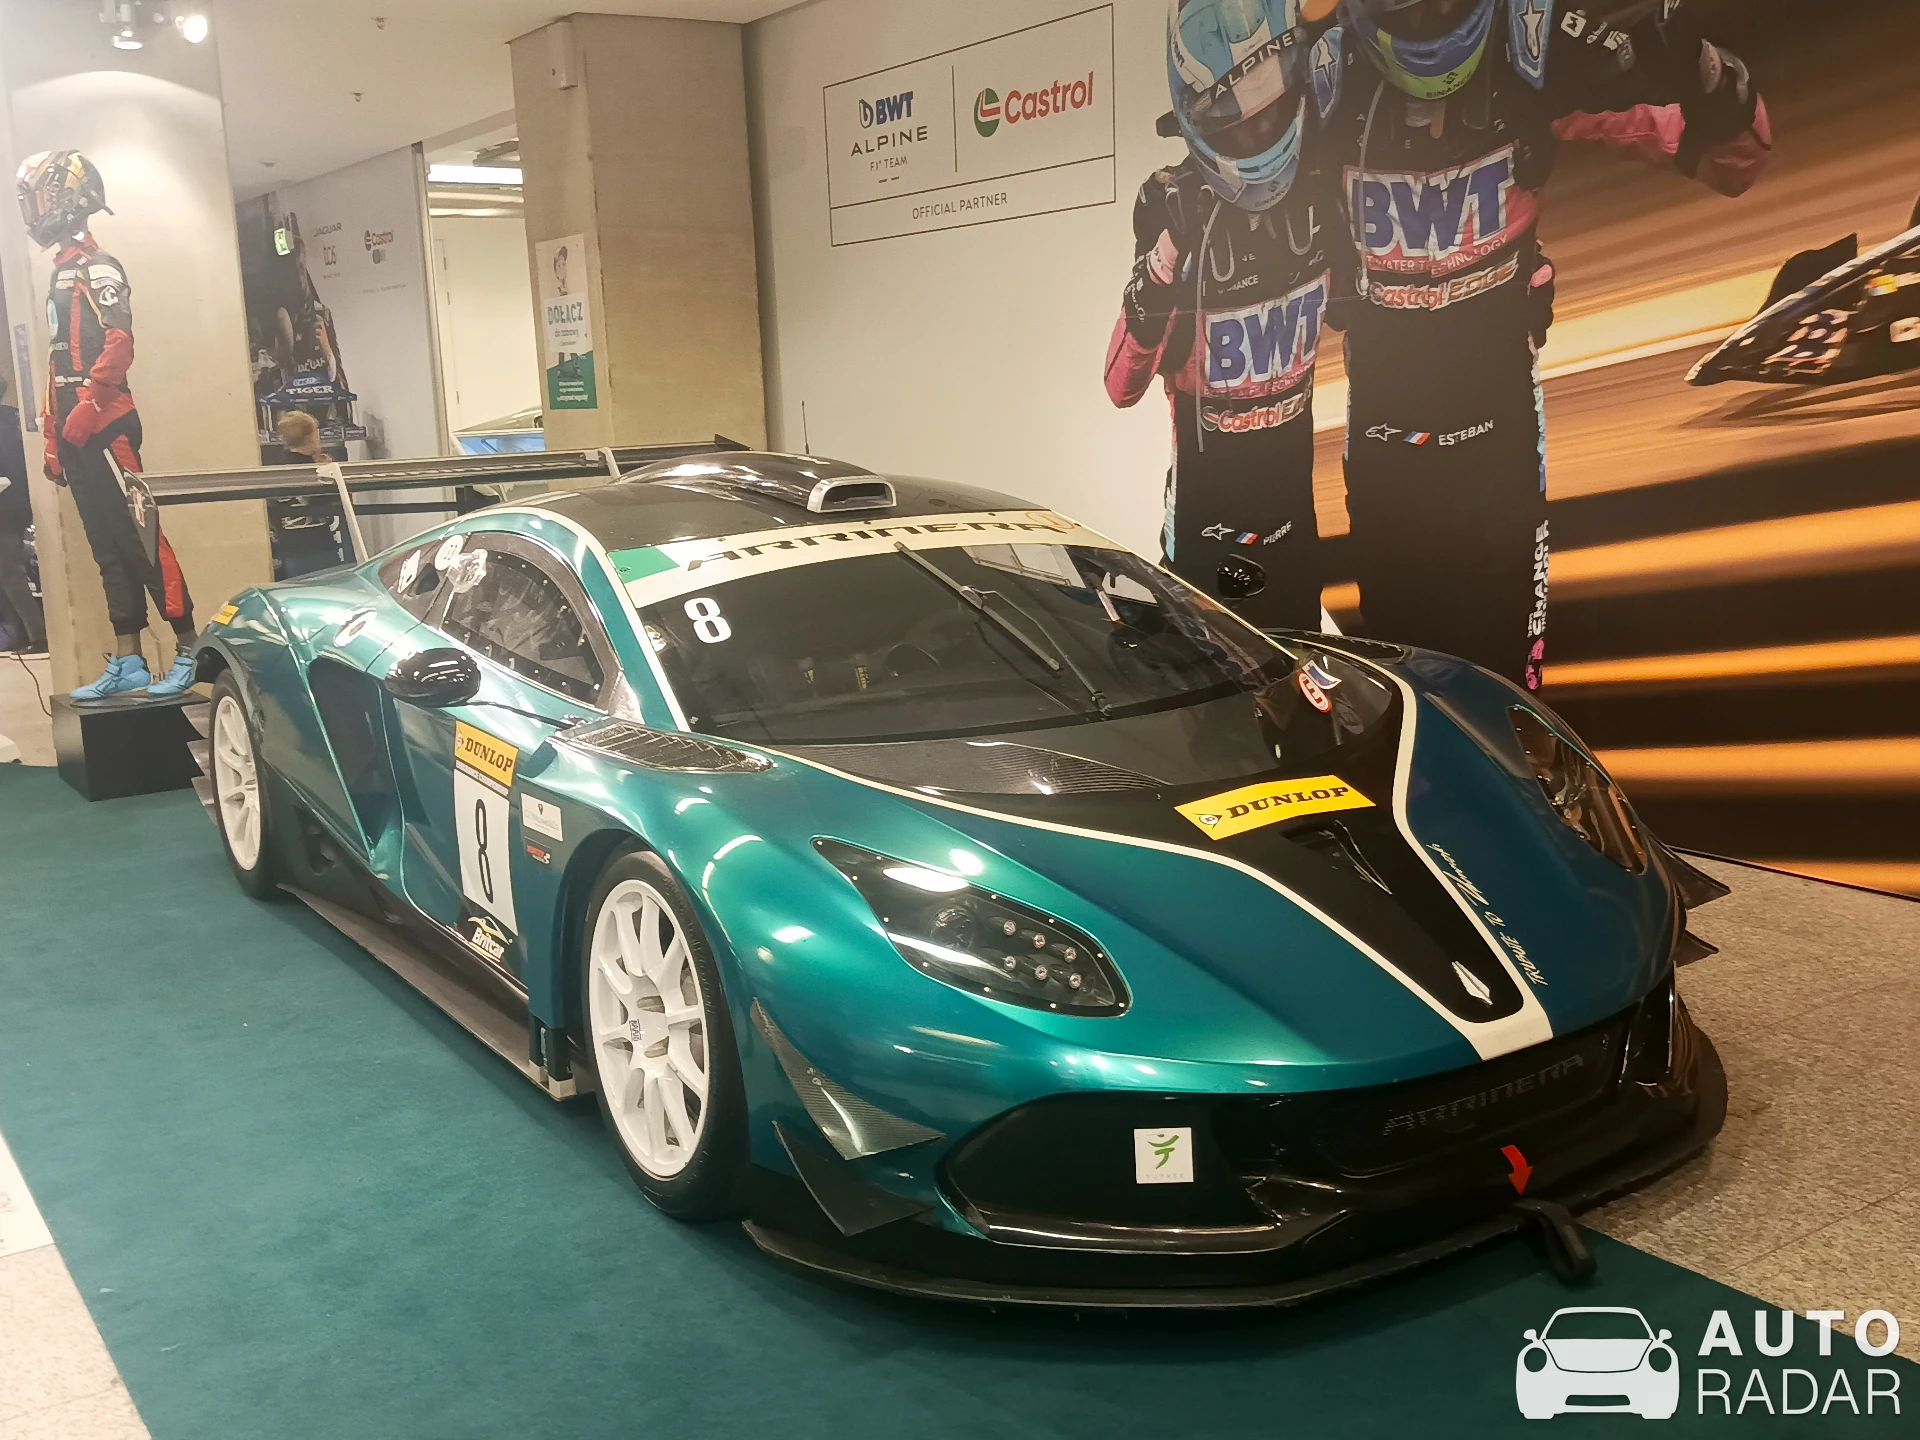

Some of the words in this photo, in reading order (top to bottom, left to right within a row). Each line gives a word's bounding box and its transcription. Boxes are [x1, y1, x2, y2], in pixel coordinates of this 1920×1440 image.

[1214, 32, 1294, 99] ALPINE
[876, 91, 913, 125] BWT
[1004, 71, 1093, 124] Castrol
[851, 125, 928, 157] ALPINE
[884, 156, 908, 169] TEAM
[912, 201, 957, 220] OFFICIAL
[959, 192, 1008, 211] PARTNER
[1350, 155, 1511, 251] BWT
[1208, 284, 1325, 383] BWT
[286, 385, 334, 395] TIGER
[1219, 404, 1279, 431] Castrol
[1438, 420, 1494, 446] ESTEBAN
[687, 520, 1068, 572] ARRINERA
[1263, 520, 1292, 546] PIERRE
[683, 597, 732, 644] 8
[464, 736, 514, 773] DUNLOP
[1226, 786, 1349, 819] DUNLOP
[475, 798, 493, 904] 8
